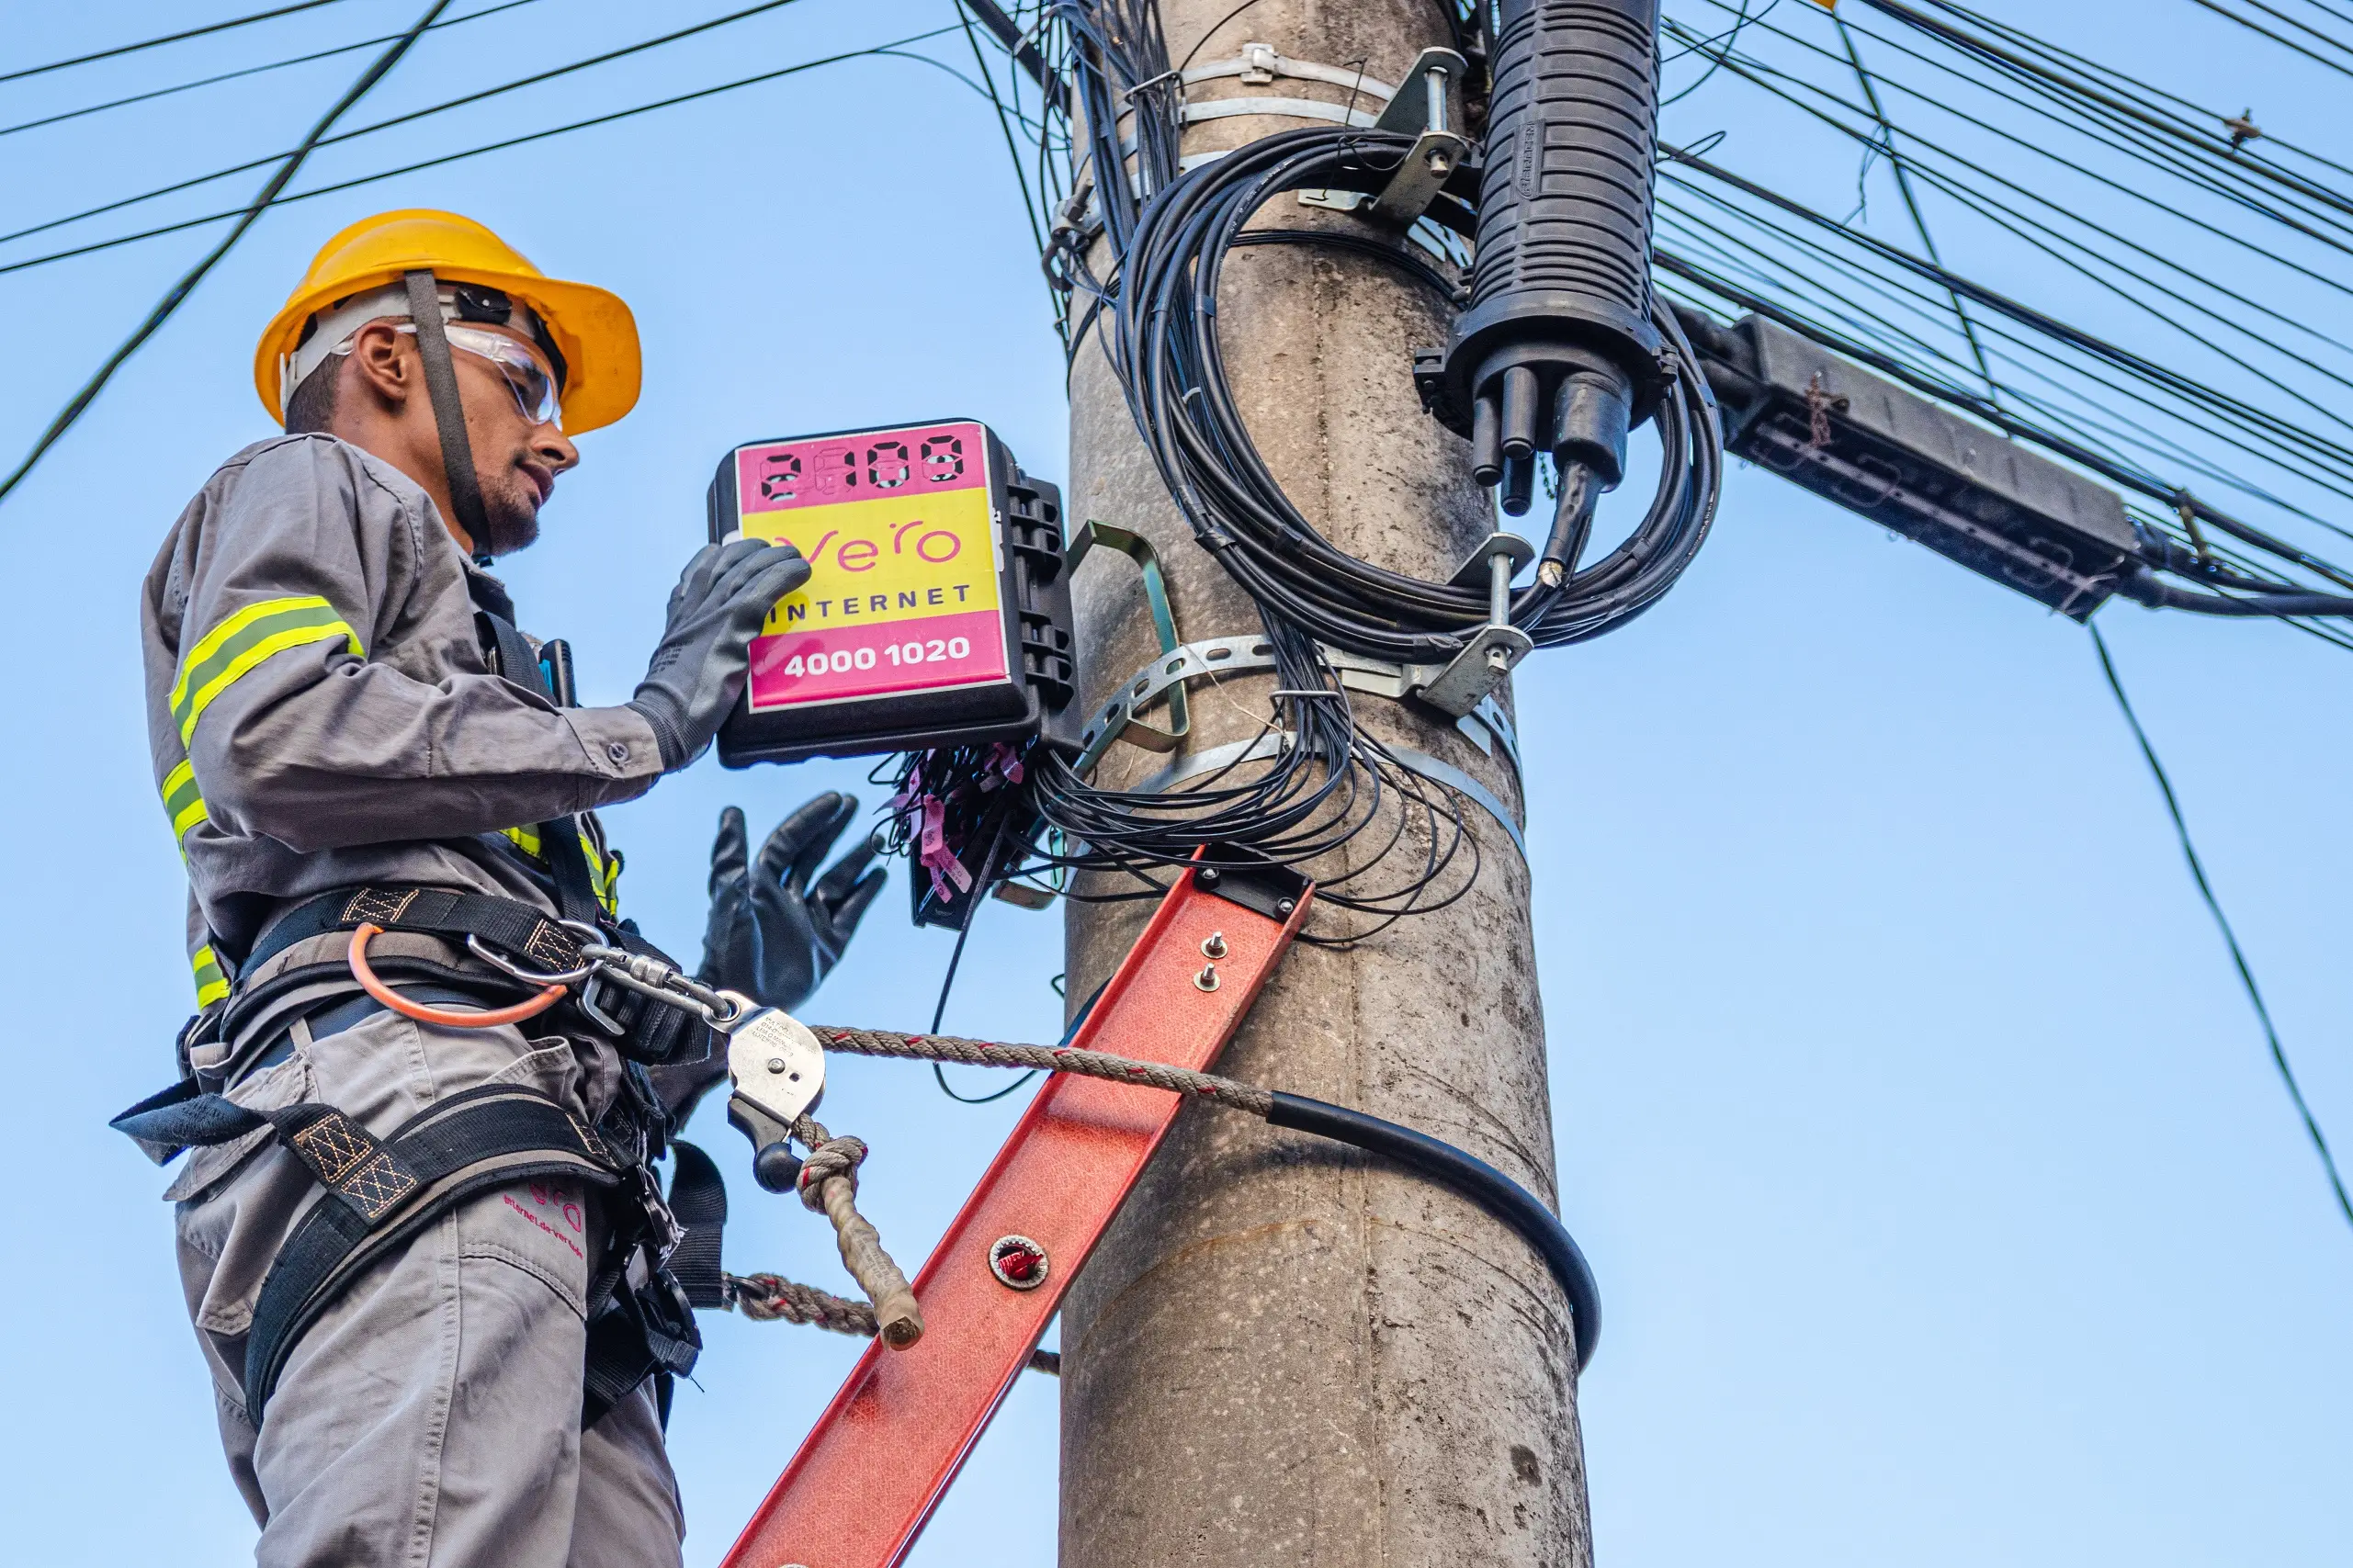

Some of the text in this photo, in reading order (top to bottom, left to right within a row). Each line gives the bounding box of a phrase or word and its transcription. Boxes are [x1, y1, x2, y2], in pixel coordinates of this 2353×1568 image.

[770, 585, 969, 623] INTERNET
[785, 637, 970, 677] 4000 1020
